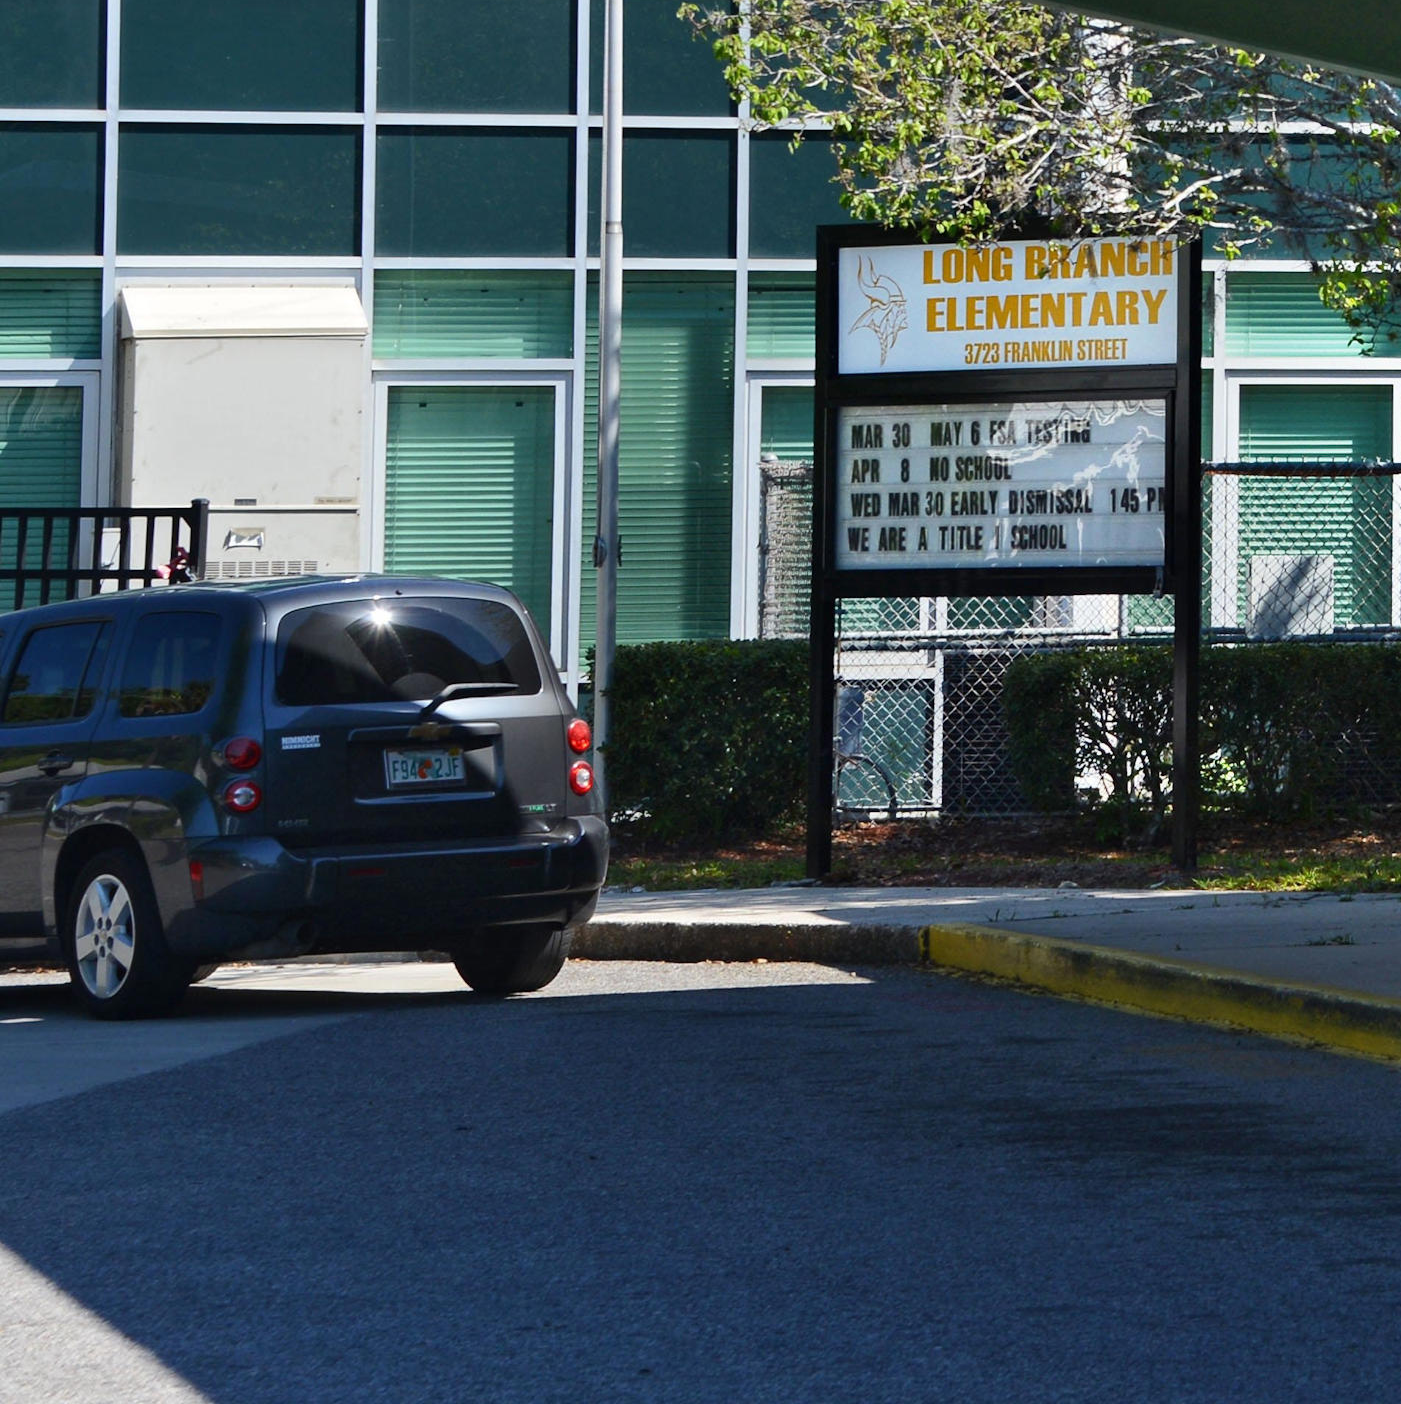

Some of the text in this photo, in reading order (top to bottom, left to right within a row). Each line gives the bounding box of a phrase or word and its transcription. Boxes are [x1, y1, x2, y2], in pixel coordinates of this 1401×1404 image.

[923, 240, 1173, 284] LONG BRANCH
[927, 289, 1168, 332] ELEMENTARY
[964, 338, 1128, 365] 3723 FRANKLIN STREET
[851, 419, 1091, 448] MAR 30 MAY 6 FSA TESTING
[851, 455, 1012, 483] APR 8 NO SCHOOL
[851, 492, 881, 517] WED
[888, 492, 920, 517] MAR
[925, 491, 944, 516] 30
[951, 490, 998, 515] EARLY
[1009, 488, 1093, 514] DISMISSAL
[848, 527, 870, 552] WE
[878, 527, 906, 551] ARE
[918, 526, 928, 551] A
[939, 526, 983, 550] TITLE
[1010, 524, 1067, 550] SCHOOL
